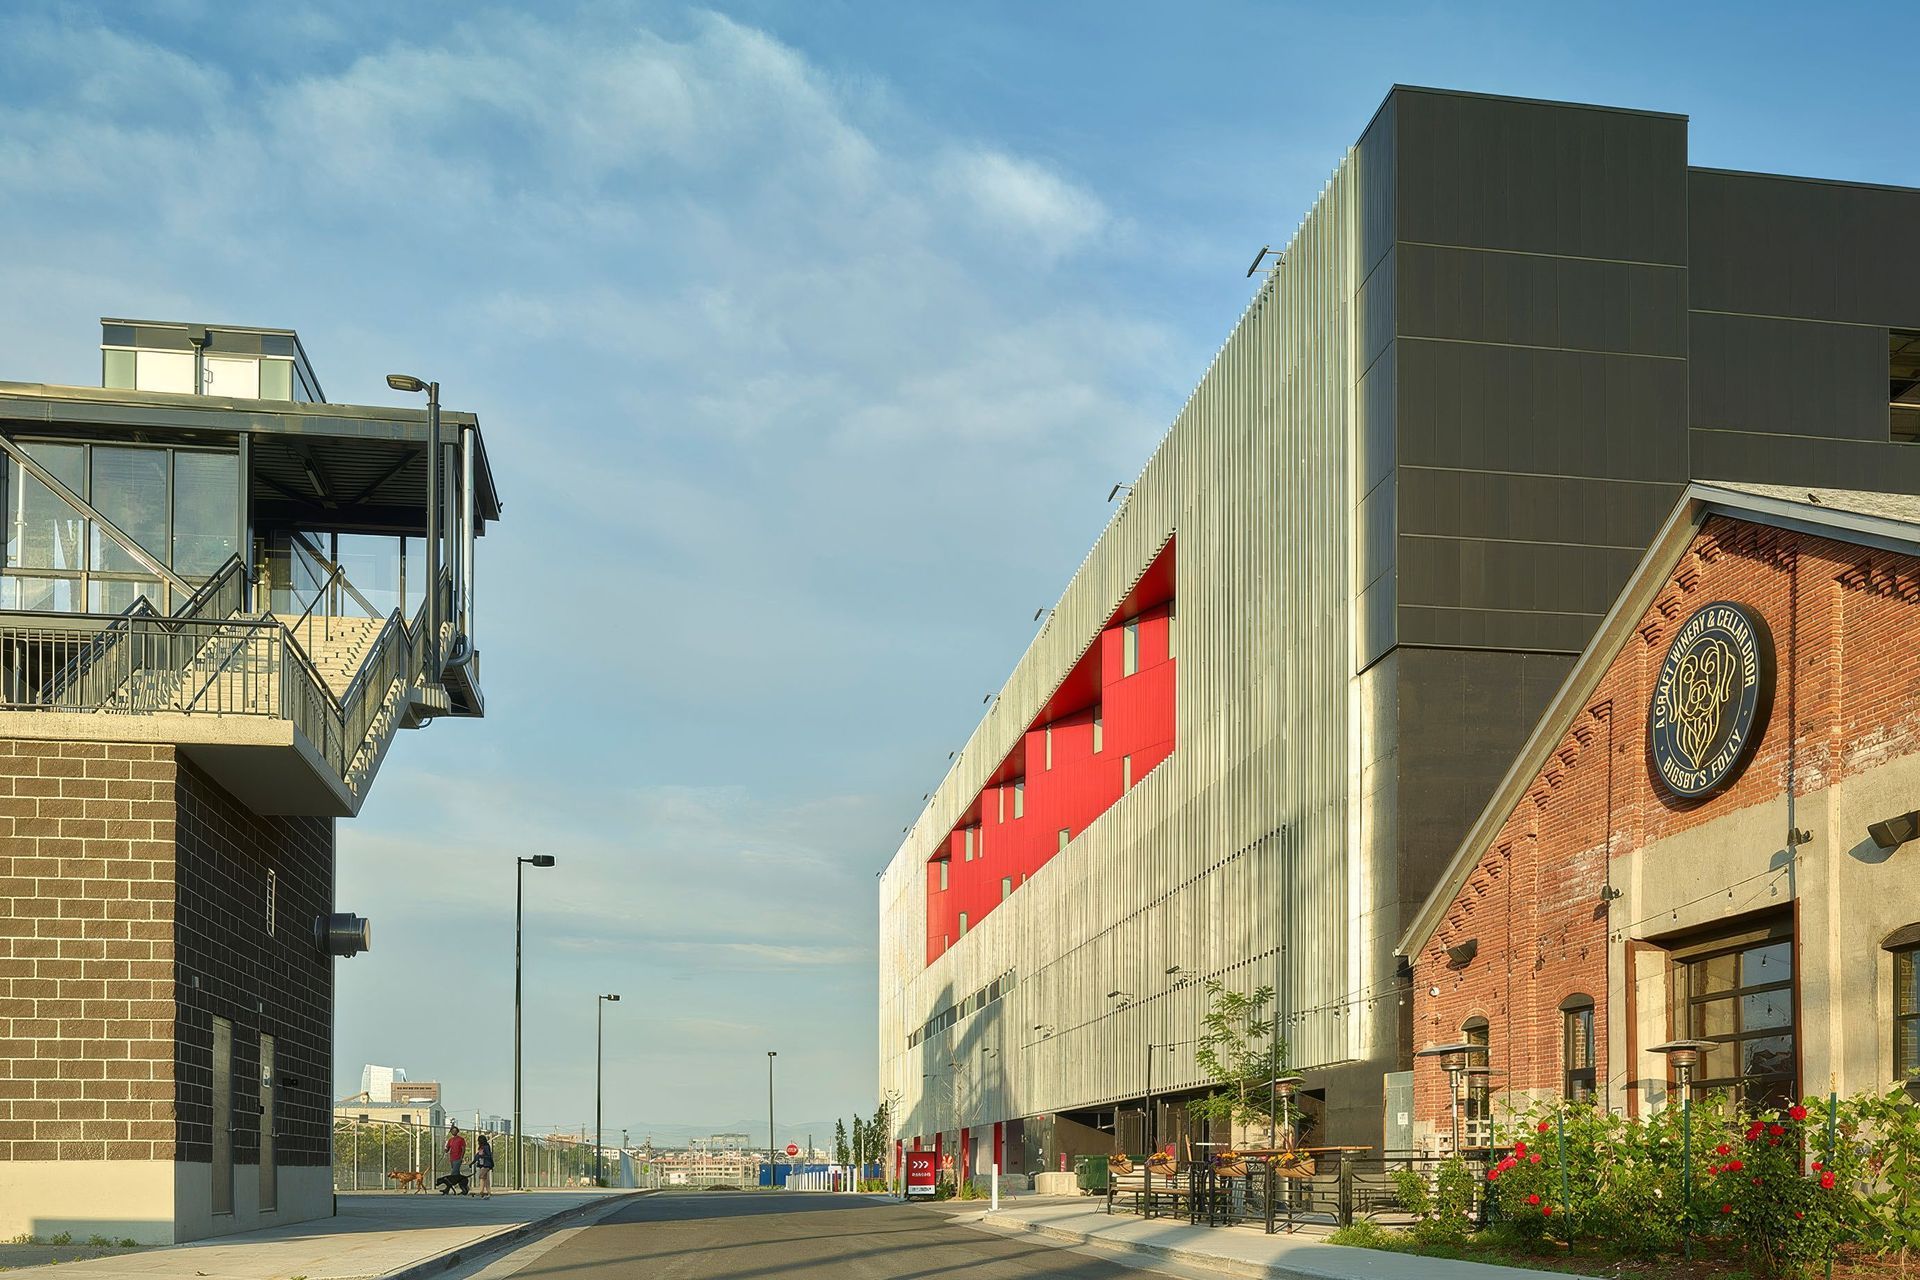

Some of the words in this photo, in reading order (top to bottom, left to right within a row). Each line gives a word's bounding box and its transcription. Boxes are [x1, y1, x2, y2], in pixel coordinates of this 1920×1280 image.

[1670, 614, 1705, 663] WINERY
[1707, 610, 1715, 628] &
[1717, 609, 1749, 647] CELLAR
[1742, 640, 1756, 688] DOOR
[1656, 664, 1675, 716] CRAFT
[1656, 719, 1665, 729] A
[1663, 756, 1707, 789] BIGSBY'S
[1711, 728, 1741, 778] FOLLY
